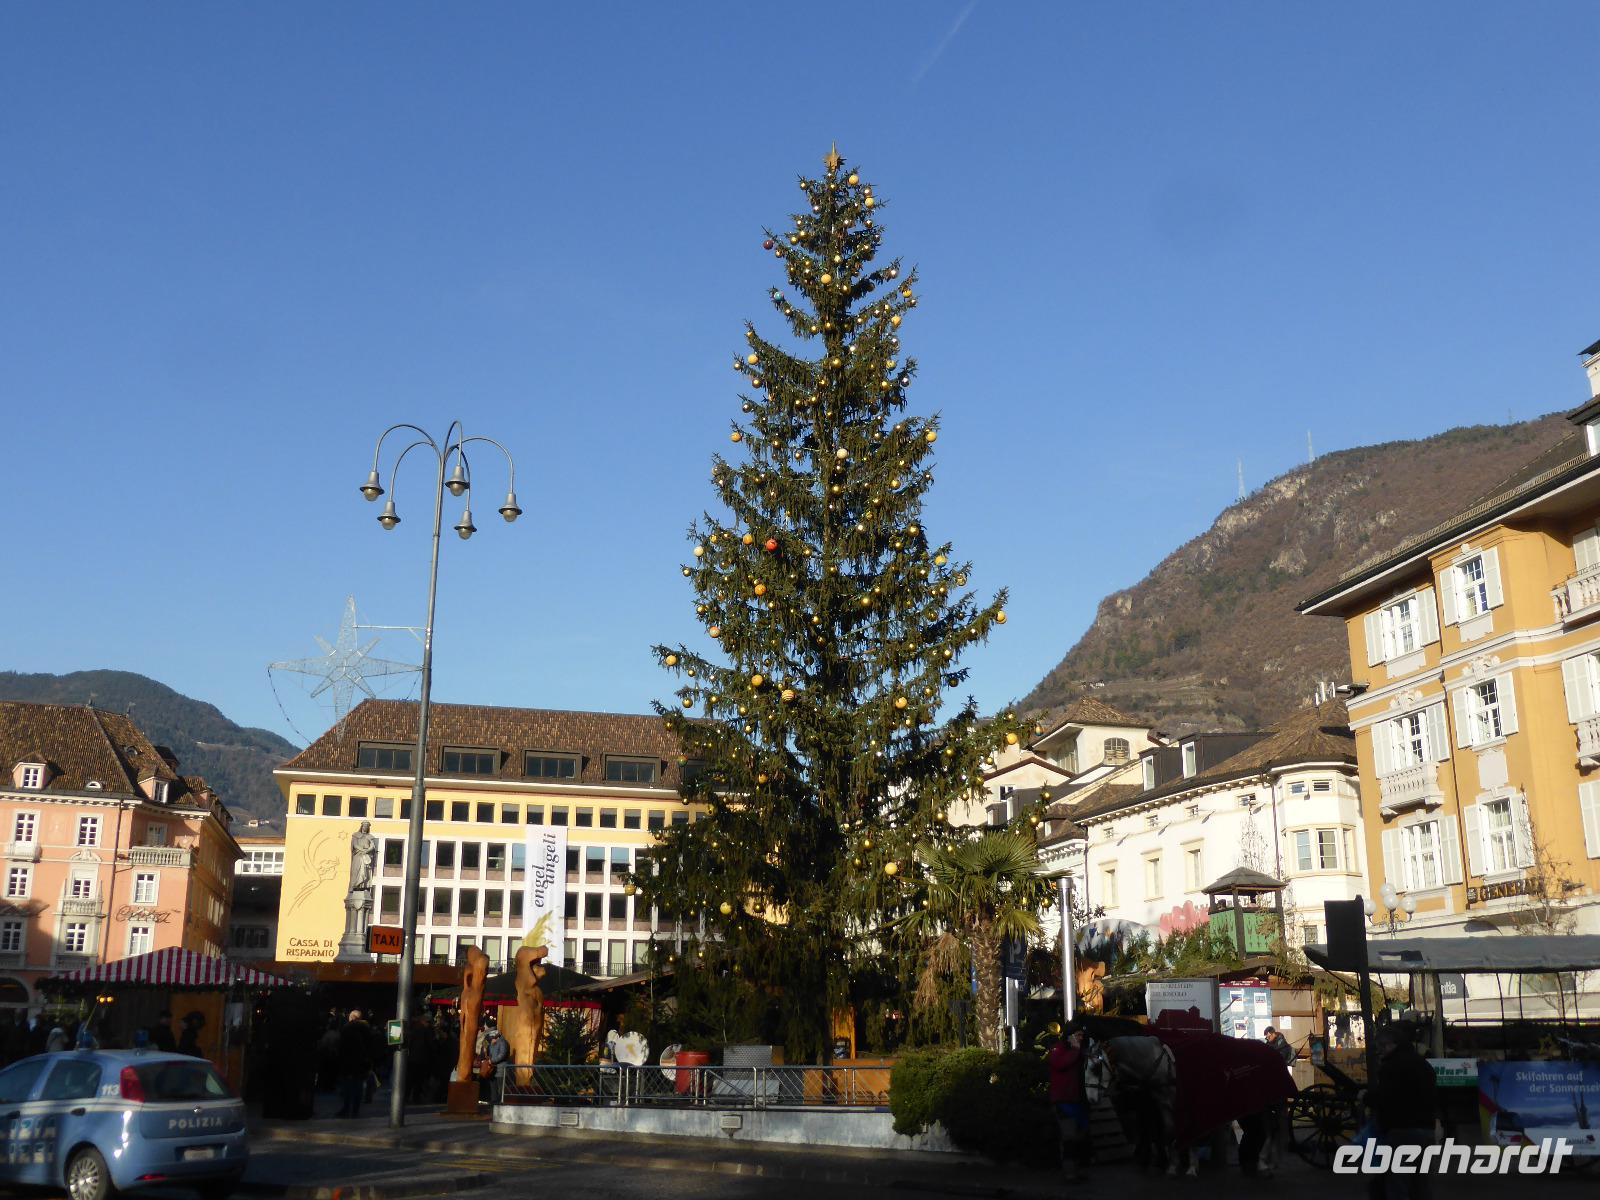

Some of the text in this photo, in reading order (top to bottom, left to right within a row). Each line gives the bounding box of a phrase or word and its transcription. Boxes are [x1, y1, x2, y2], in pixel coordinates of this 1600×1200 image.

[543, 833, 560, 885] angeli
[532, 864, 548, 908] engel
[289, 937, 333, 948] CASSA DI
[373, 933, 400, 947] TAXI
[286, 948, 335, 957] RISPARMIO
[1515, 1070, 1584, 1082] Skifahren auf
[102, 1084, 119, 1096] 113
[1529, 1083, 1546, 1093] der
[168, 1118, 223, 1130] POLIZIA
